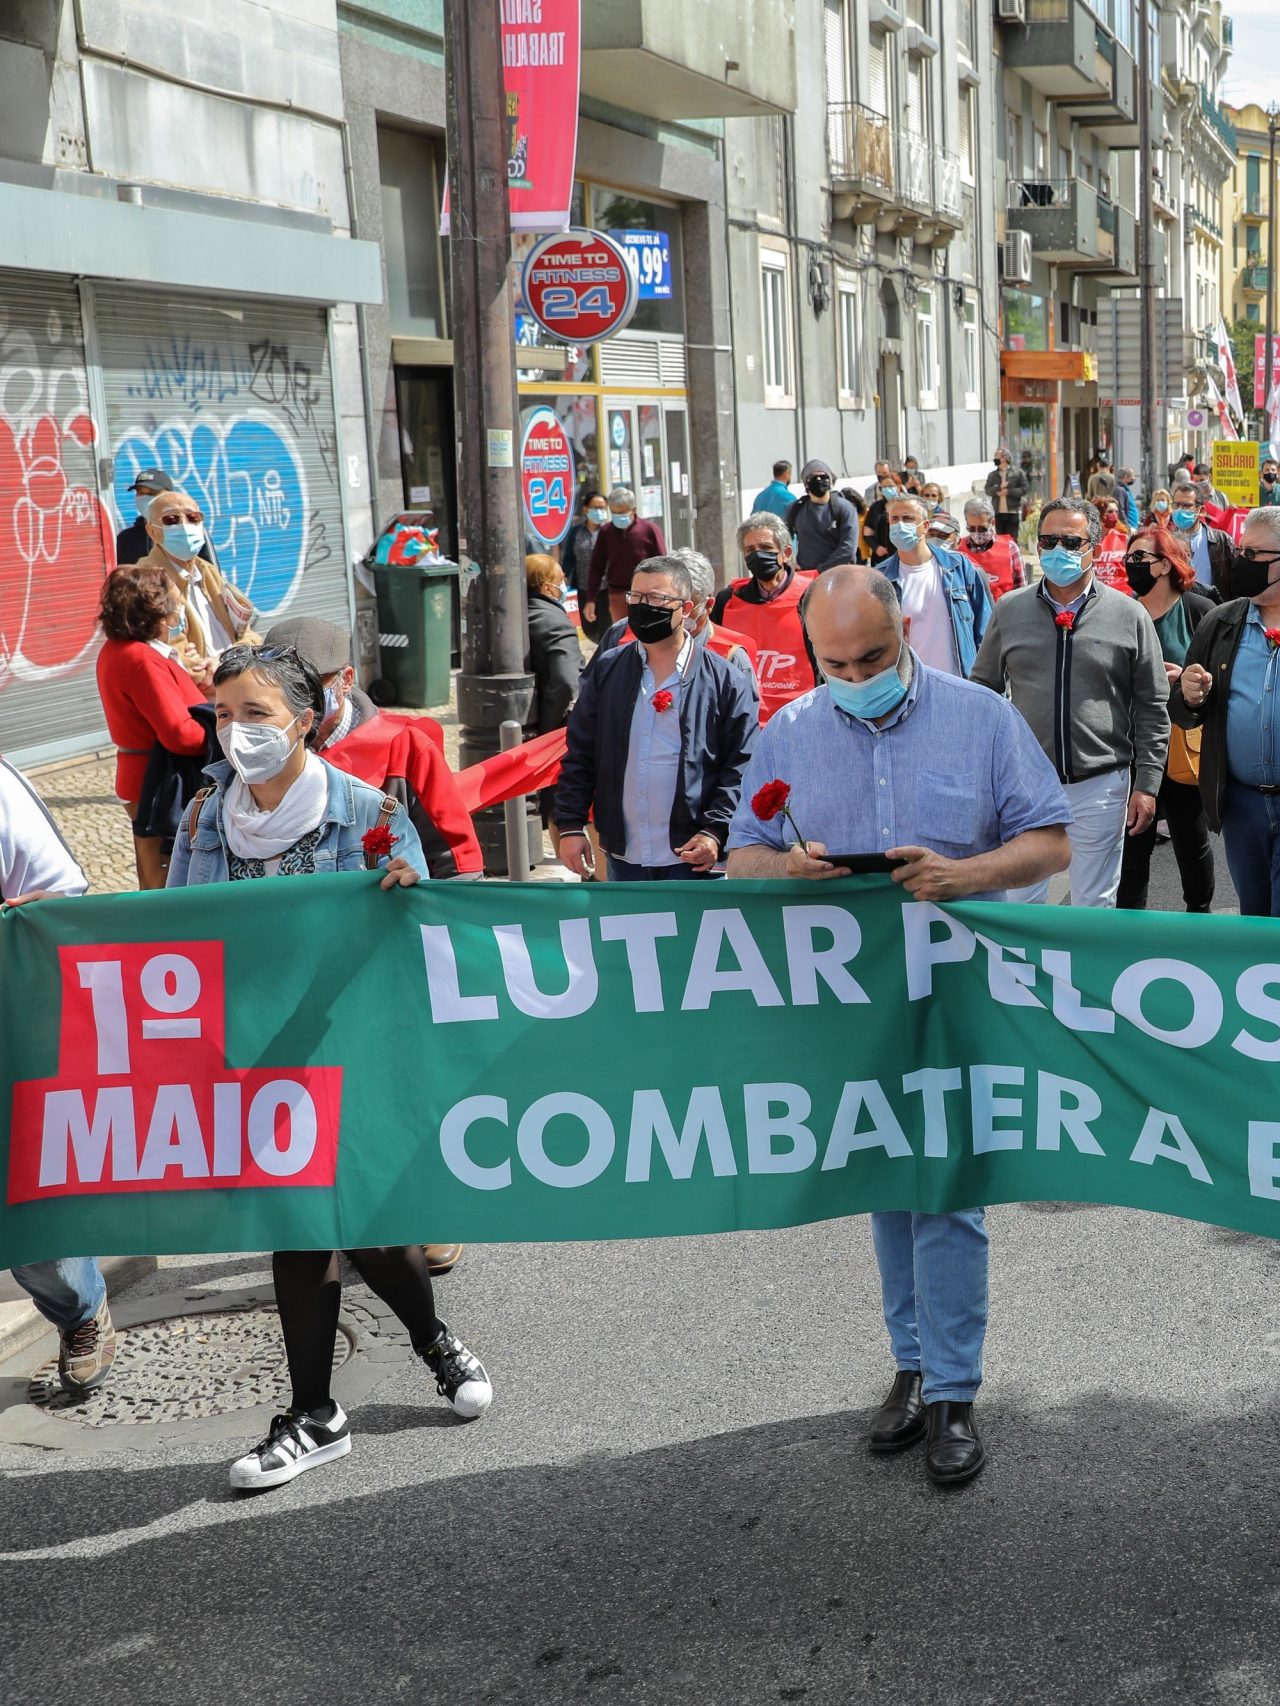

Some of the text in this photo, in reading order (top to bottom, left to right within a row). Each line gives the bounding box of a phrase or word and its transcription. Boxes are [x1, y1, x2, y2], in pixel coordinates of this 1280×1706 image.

[532, 267, 620, 284] FITNESS
[540, 253, 608, 265] TIME TO
[541, 286, 615, 320] 24
[528, 438, 562, 450] TIME TO
[1216, 452, 1255, 469] SALÁRIO
[523, 455, 568, 473] FITNESS
[529, 477, 567, 517] 24
[419, 904, 872, 1024] LUTAR
[77, 953, 201, 1075] 1º
[38, 1079, 317, 1187] MAIO
[439, 1064, 1107, 1190] COMBATER
[1129, 1106, 1214, 1185] A
